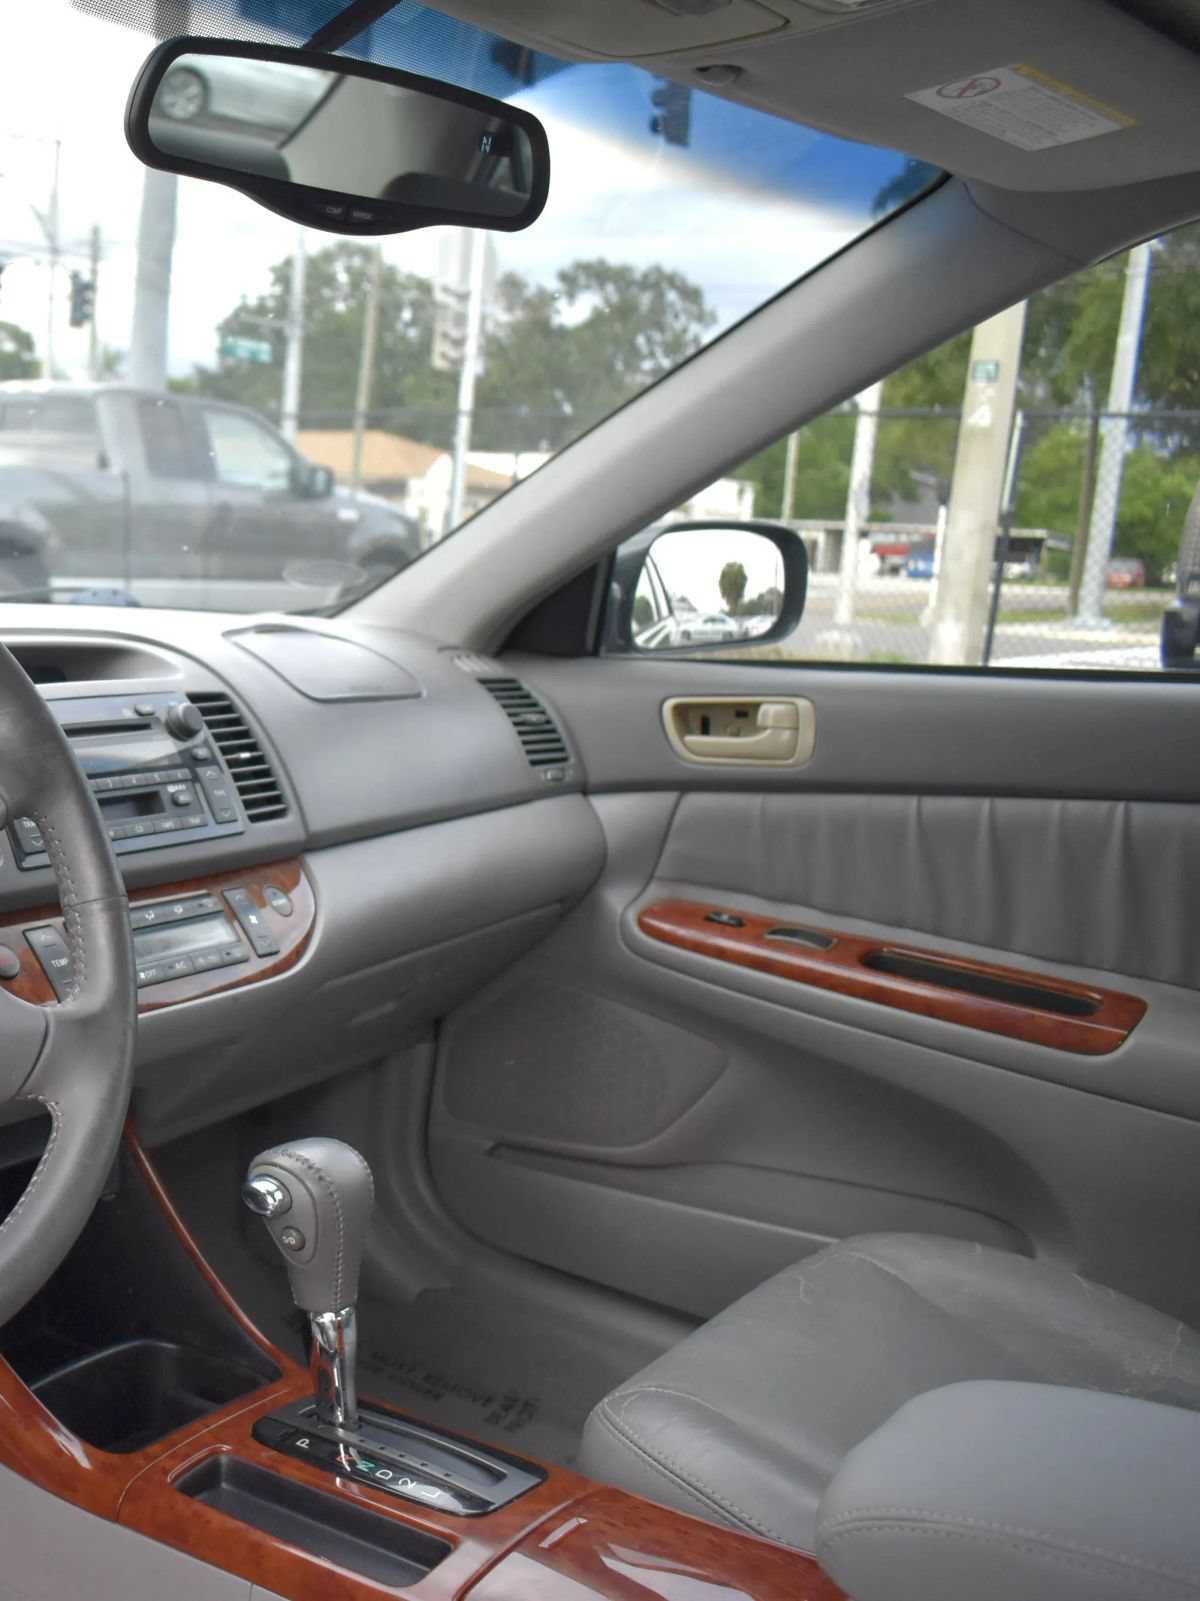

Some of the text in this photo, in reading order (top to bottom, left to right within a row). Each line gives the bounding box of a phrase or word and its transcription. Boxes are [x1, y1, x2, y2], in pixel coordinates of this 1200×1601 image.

[23, 820, 36, 828] TRA
[50, 957, 69, 967] TEMP
[296, 1438, 310, 1449] P
[355, 1460, 375, 1472] N
[375, 1469, 393, 1480] D
[398, 1477, 417, 1489] 2
[420, 1487, 441, 1498] L
